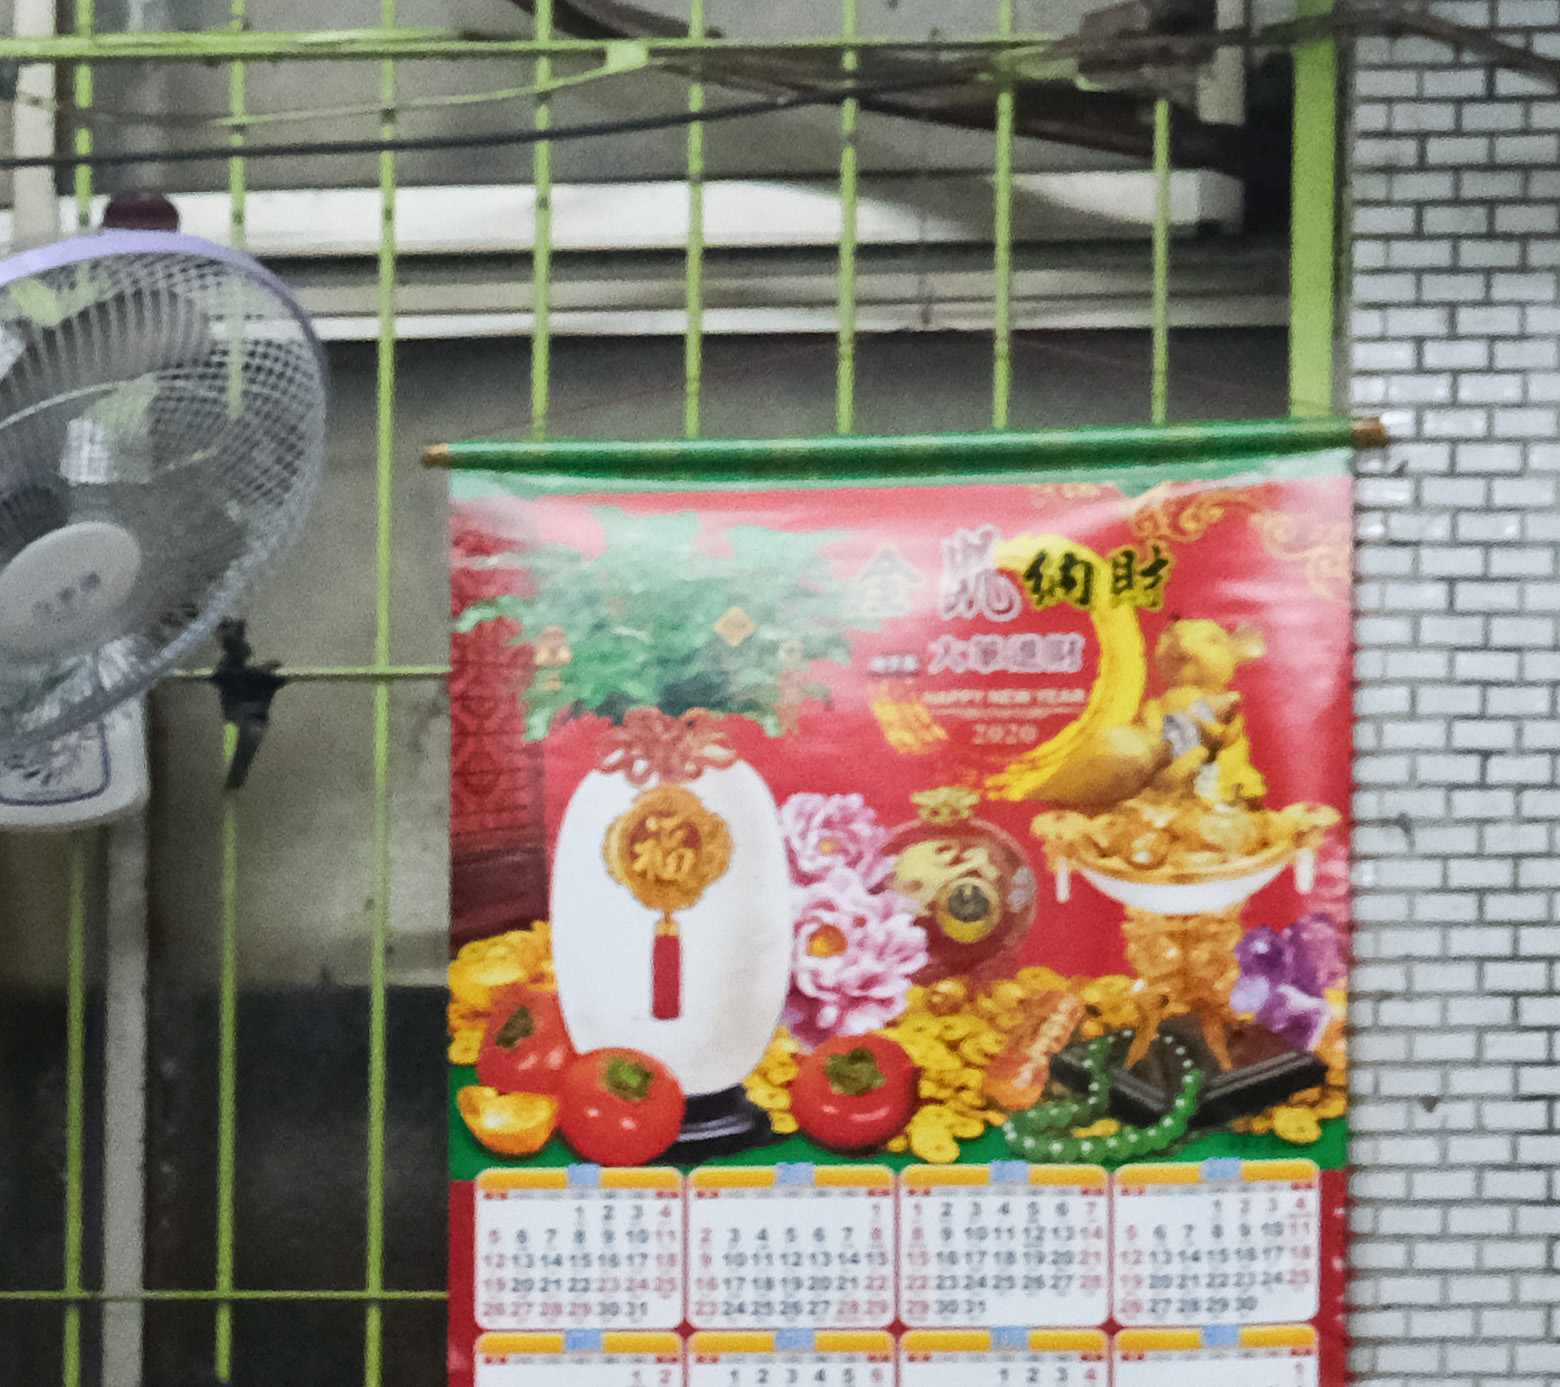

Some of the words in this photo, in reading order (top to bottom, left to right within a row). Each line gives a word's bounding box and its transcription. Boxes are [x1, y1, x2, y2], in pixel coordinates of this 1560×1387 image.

[923, 689, 983, 706] HAPPY
[987, 689, 1031, 704] NEW
[1037, 688, 1086, 703] YEAR
[972, 723, 1039, 745] 2020
